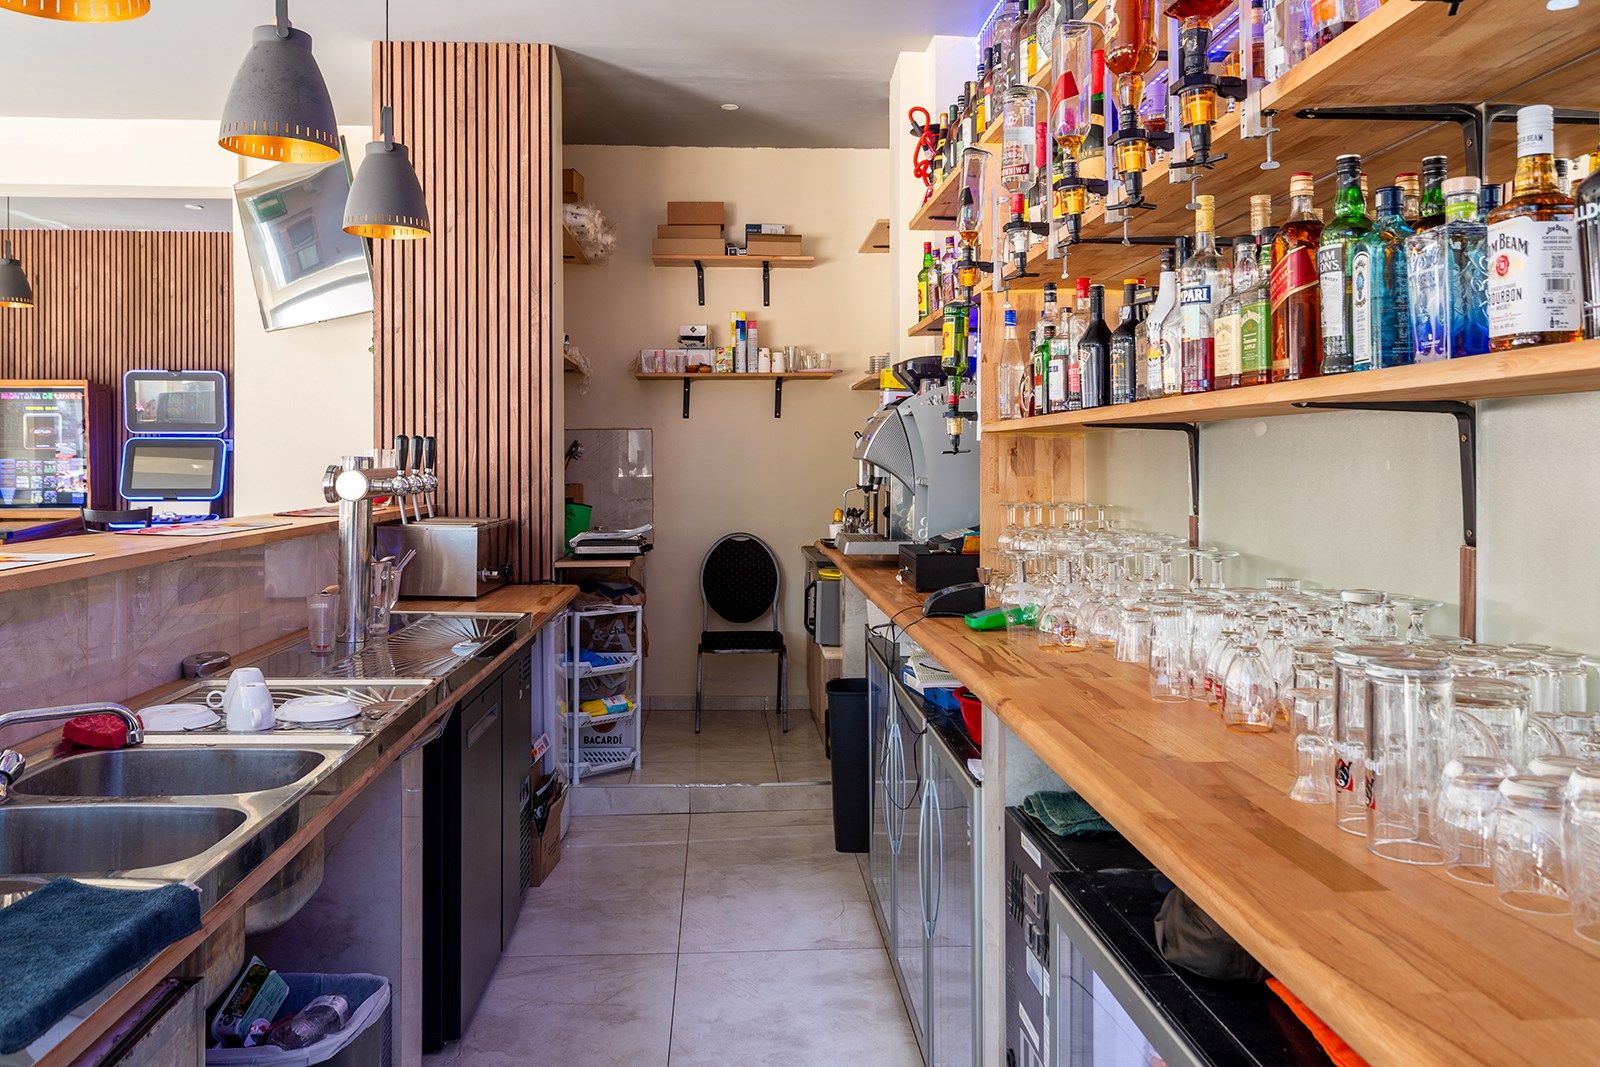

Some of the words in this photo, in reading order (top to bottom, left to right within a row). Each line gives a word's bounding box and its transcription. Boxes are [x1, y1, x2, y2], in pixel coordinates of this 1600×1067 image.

[1499, 232, 1529, 257] BEAM
[0, 391, 41, 400] MONTANA
[42, 391, 53, 400] DE
[583, 733, 623, 745] BACARDÍ
